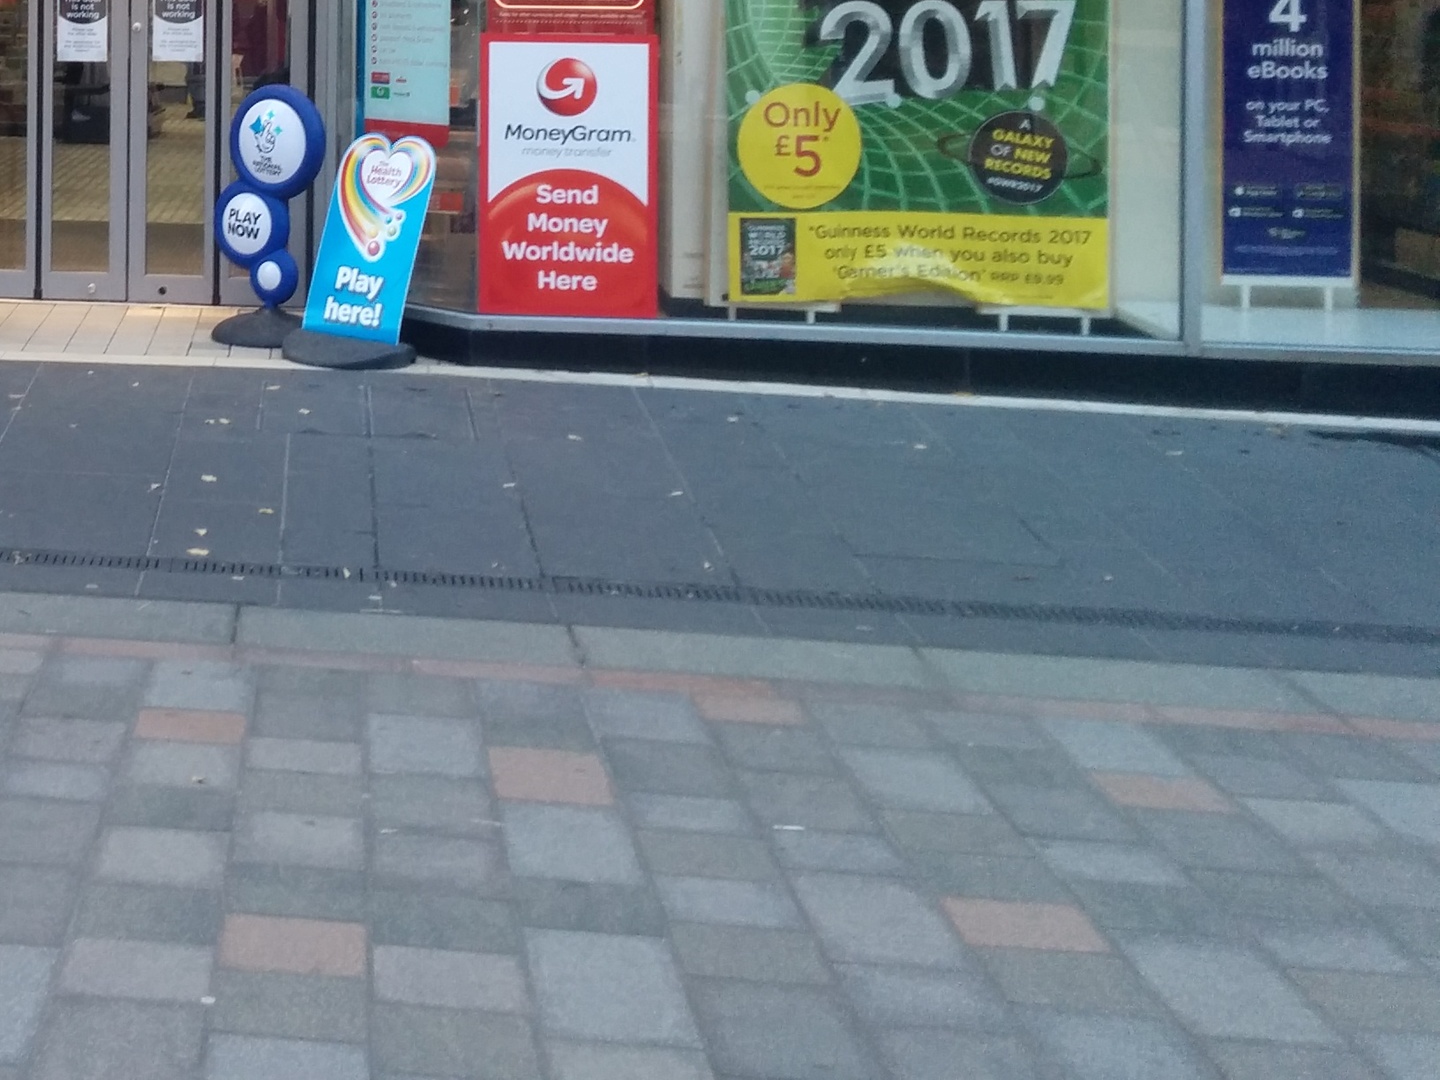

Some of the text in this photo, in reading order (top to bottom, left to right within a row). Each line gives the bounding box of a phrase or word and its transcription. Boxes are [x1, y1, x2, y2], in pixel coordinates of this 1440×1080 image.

[66, 10, 100, 19] working
[71, 2, 79, 10] is
[1251, 38, 1324, 58] million
[1246, 61, 1329, 80] eBooks
[1245, 99, 1330, 114] on your PC,
[763, 101, 841, 132] Only
[1019, 118, 1032, 131] A
[1256, 114, 1321, 129] Tablet or
[504, 123, 632, 145] MoneyGram
[991, 128, 1056, 149] GALAXY
[1242, 129, 1332, 146] Smartphone
[521, 146, 613, 159] money transfer
[990, 143, 1052, 164] OF NEW
[371, 165, 403, 177] Health
[984, 157, 1052, 181] RECORDS
[366, 175, 403, 187] Lottery
[535, 183, 599, 205] Send
[228, 208, 262, 224] PLAY
[527, 213, 609, 238] Money
[227, 223, 261, 240] NOW
[897, 224, 956, 241] World
[962, 226, 1042, 243] Records
[1048, 229, 1092, 245] 2017
[501, 240, 634, 264] Worldwide
[748, 245, 785, 257] 2017
[824, 244, 1074, 268] only £5 when you also buy
[335, 266, 383, 299] Play
[537, 270, 598, 291] Here
[990, 271, 1020, 283] RRP
[1024, 271, 1065, 286] £9.99
[323, 296, 381, 327] here!
